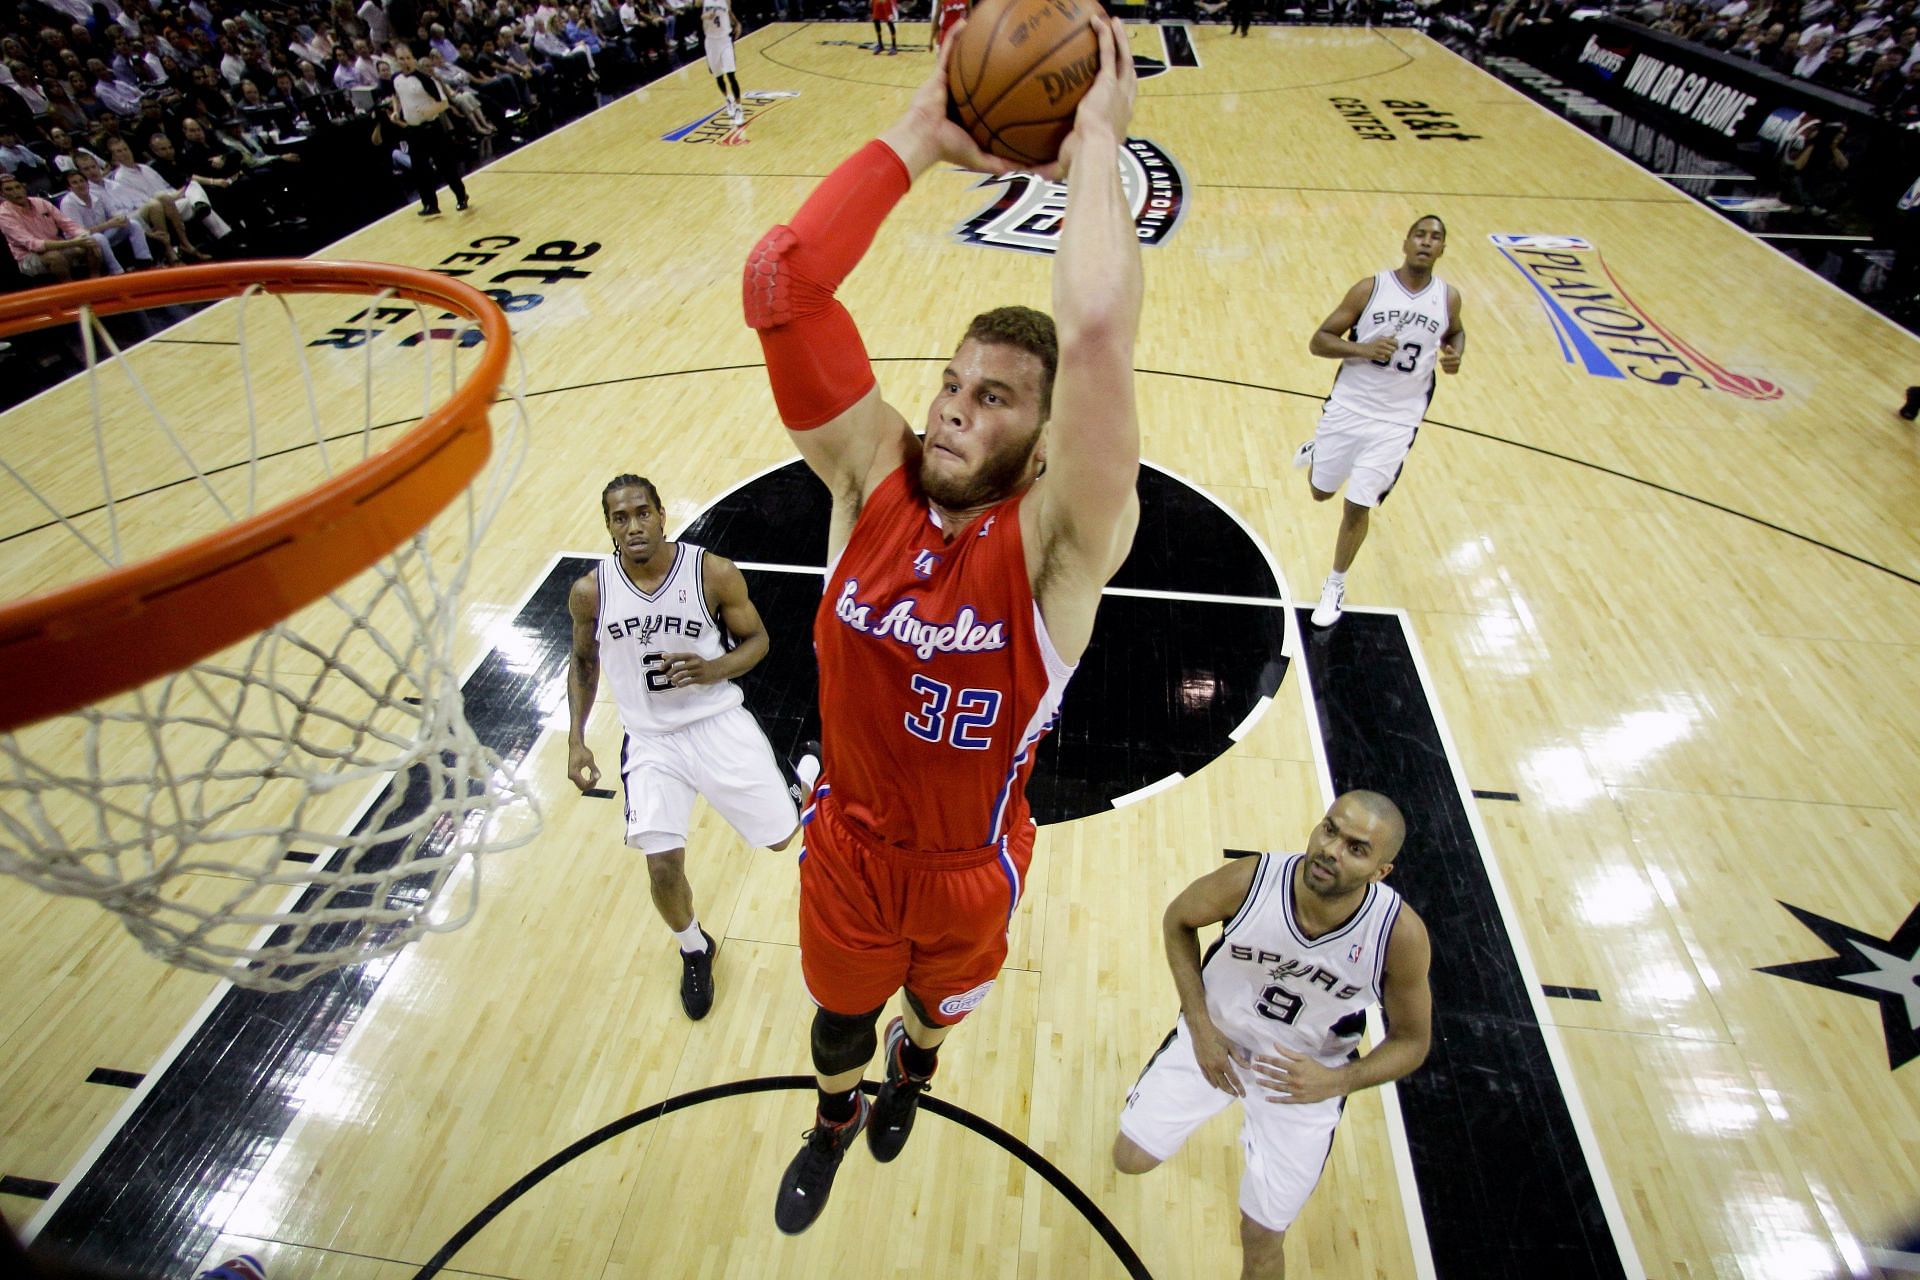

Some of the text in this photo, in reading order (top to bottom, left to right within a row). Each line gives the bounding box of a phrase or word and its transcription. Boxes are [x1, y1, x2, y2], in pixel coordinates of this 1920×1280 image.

[1328, 97, 1397, 141] CENTER
[1381, 99, 1483, 140] at&t
[1623, 53, 1665, 96] WIN
[1649, 64, 1684, 105] OR
[1669, 72, 1708, 114] GO
[1690, 81, 1757, 137] HOME
[1128, 144, 1173, 237] SAN ANTONIO
[1373, 310, 1440, 334] SPURS
[1514, 248, 1712, 389] PLAYOFFS
[608, 614, 703, 646] SPURS
[835, 579, 1006, 661] Los Angeles
[641, 651, 680, 693] 2
[904, 673, 1002, 750] 32
[1230, 943, 1363, 1000] SPURS
[1254, 983, 1307, 1026] 9
